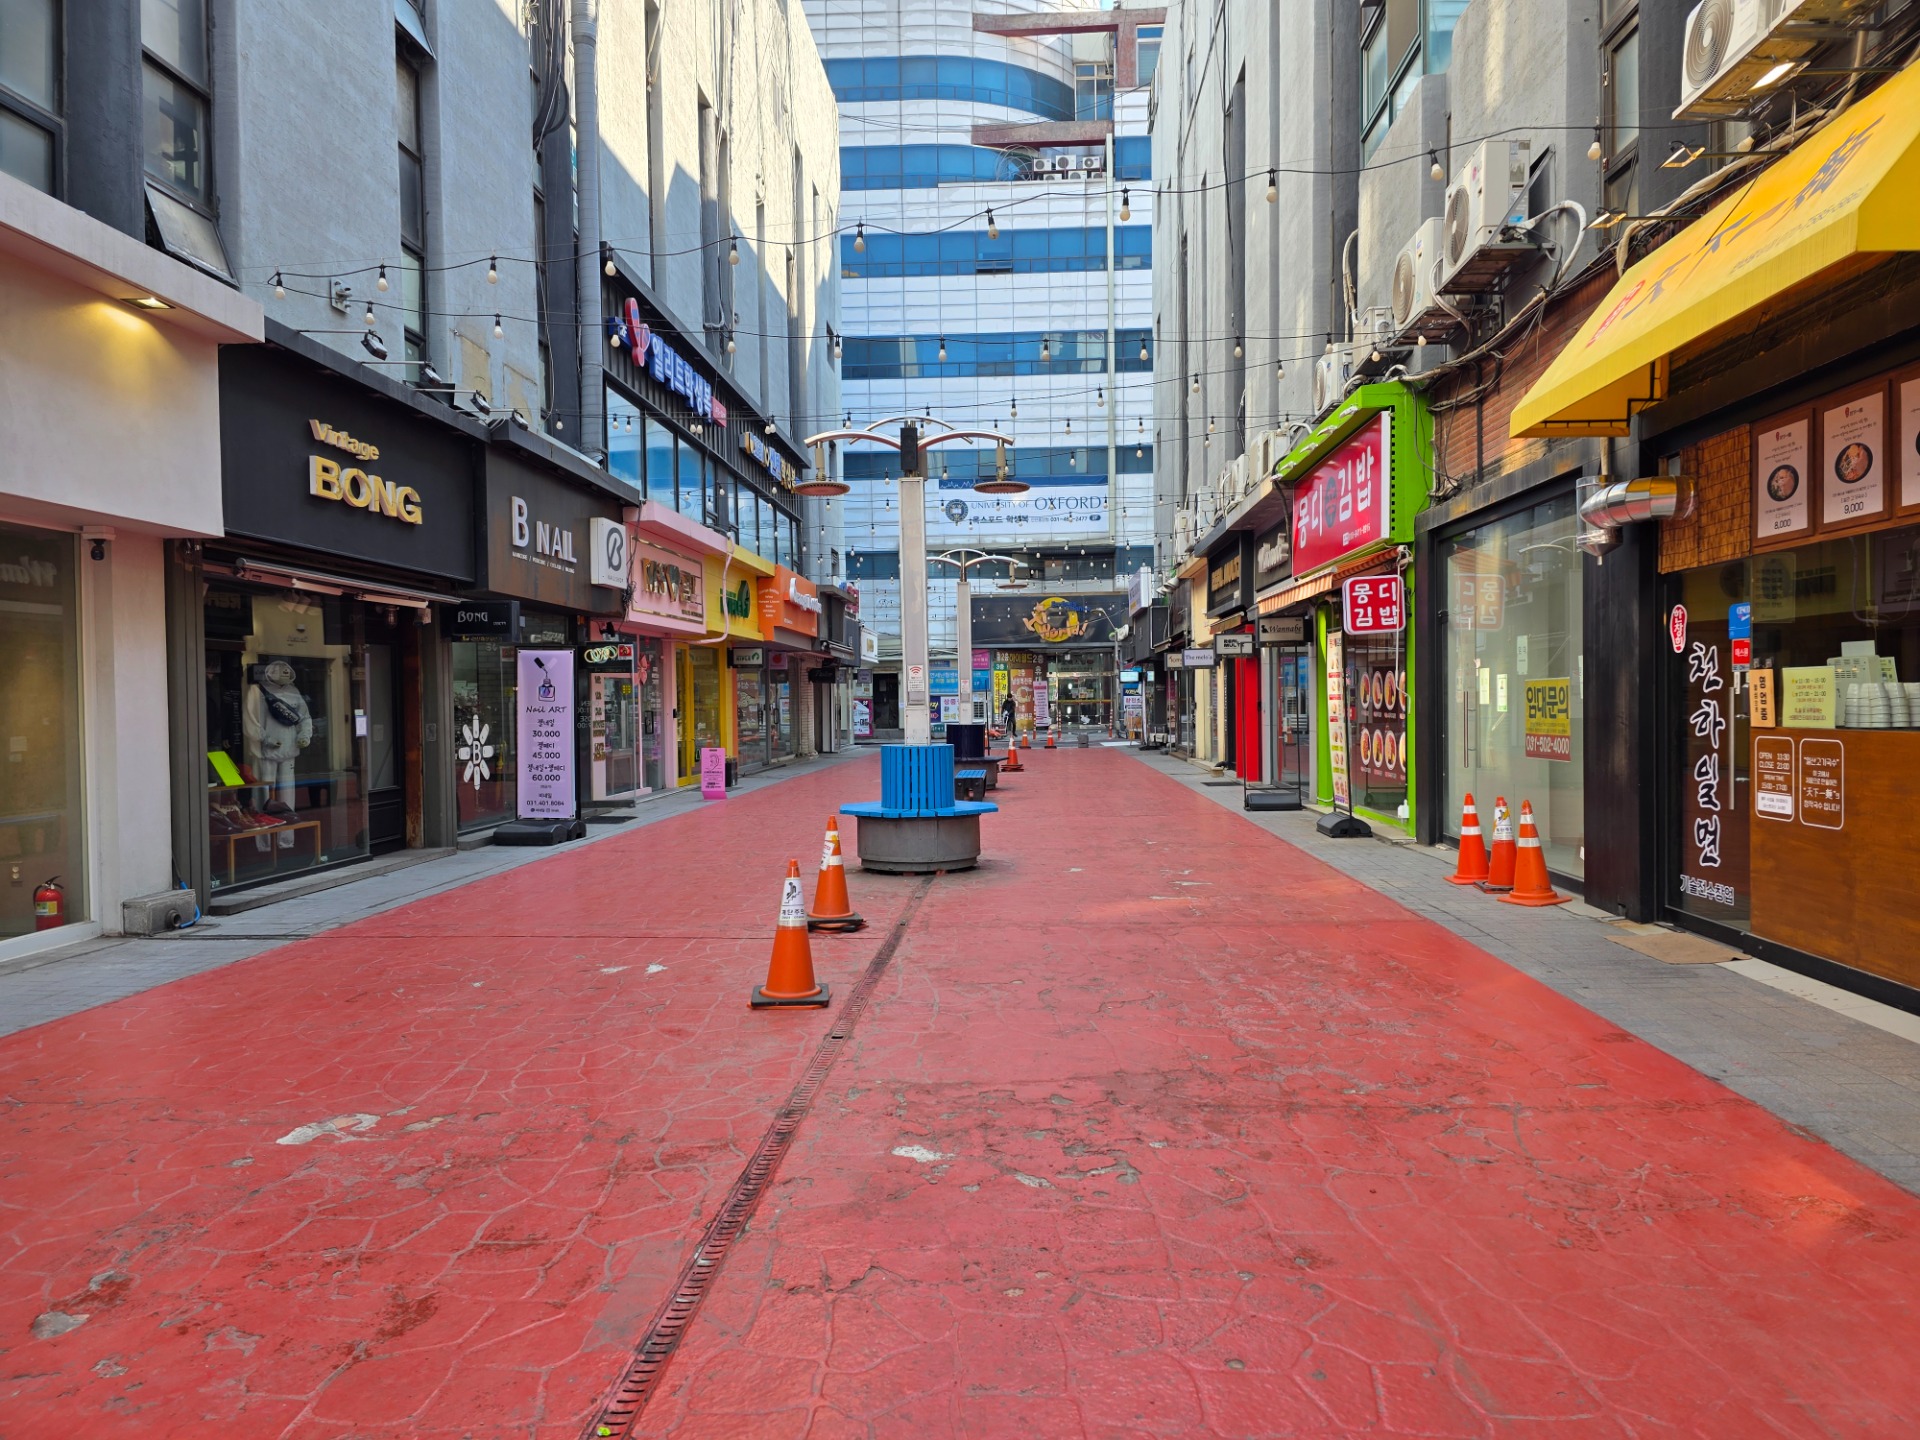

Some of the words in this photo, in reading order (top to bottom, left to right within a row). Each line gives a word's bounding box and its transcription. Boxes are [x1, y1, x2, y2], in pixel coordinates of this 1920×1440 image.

[309, 419, 380, 460] Vintage
[309, 455, 423, 525] BONG
[1297, 484, 1323, 548] 몽디
[1337, 445, 1374, 522] 김밥
[971, 501, 1016, 510] UNIVESITY
[1035, 495, 1101, 511] OXFORD
[1844, 501, 1864, 514] 9,000
[511, 495, 530, 548] B
[536, 520, 577, 563] NAIL
[1774, 519, 1791, 530] 8,000
[457, 611, 488, 622] BONG
[1353, 605, 1399, 627] 김밥
[1269, 624, 1302, 634] Wannabe
[526, 705, 545, 713] Nail
[548, 705, 567, 713] ART
[1526, 685, 1569, 719] 임대문의
[1526, 735, 1570, 754] 031-502-4000
[1688, 642, 1726, 867] 천하일면
[1758, 751, 1773, 760] OPEN
[1758, 760, 1775, 769] CLOSE
[1776, 761, 1790, 770] 21:00
[1680, 874, 1735, 906] 기술전수창업
